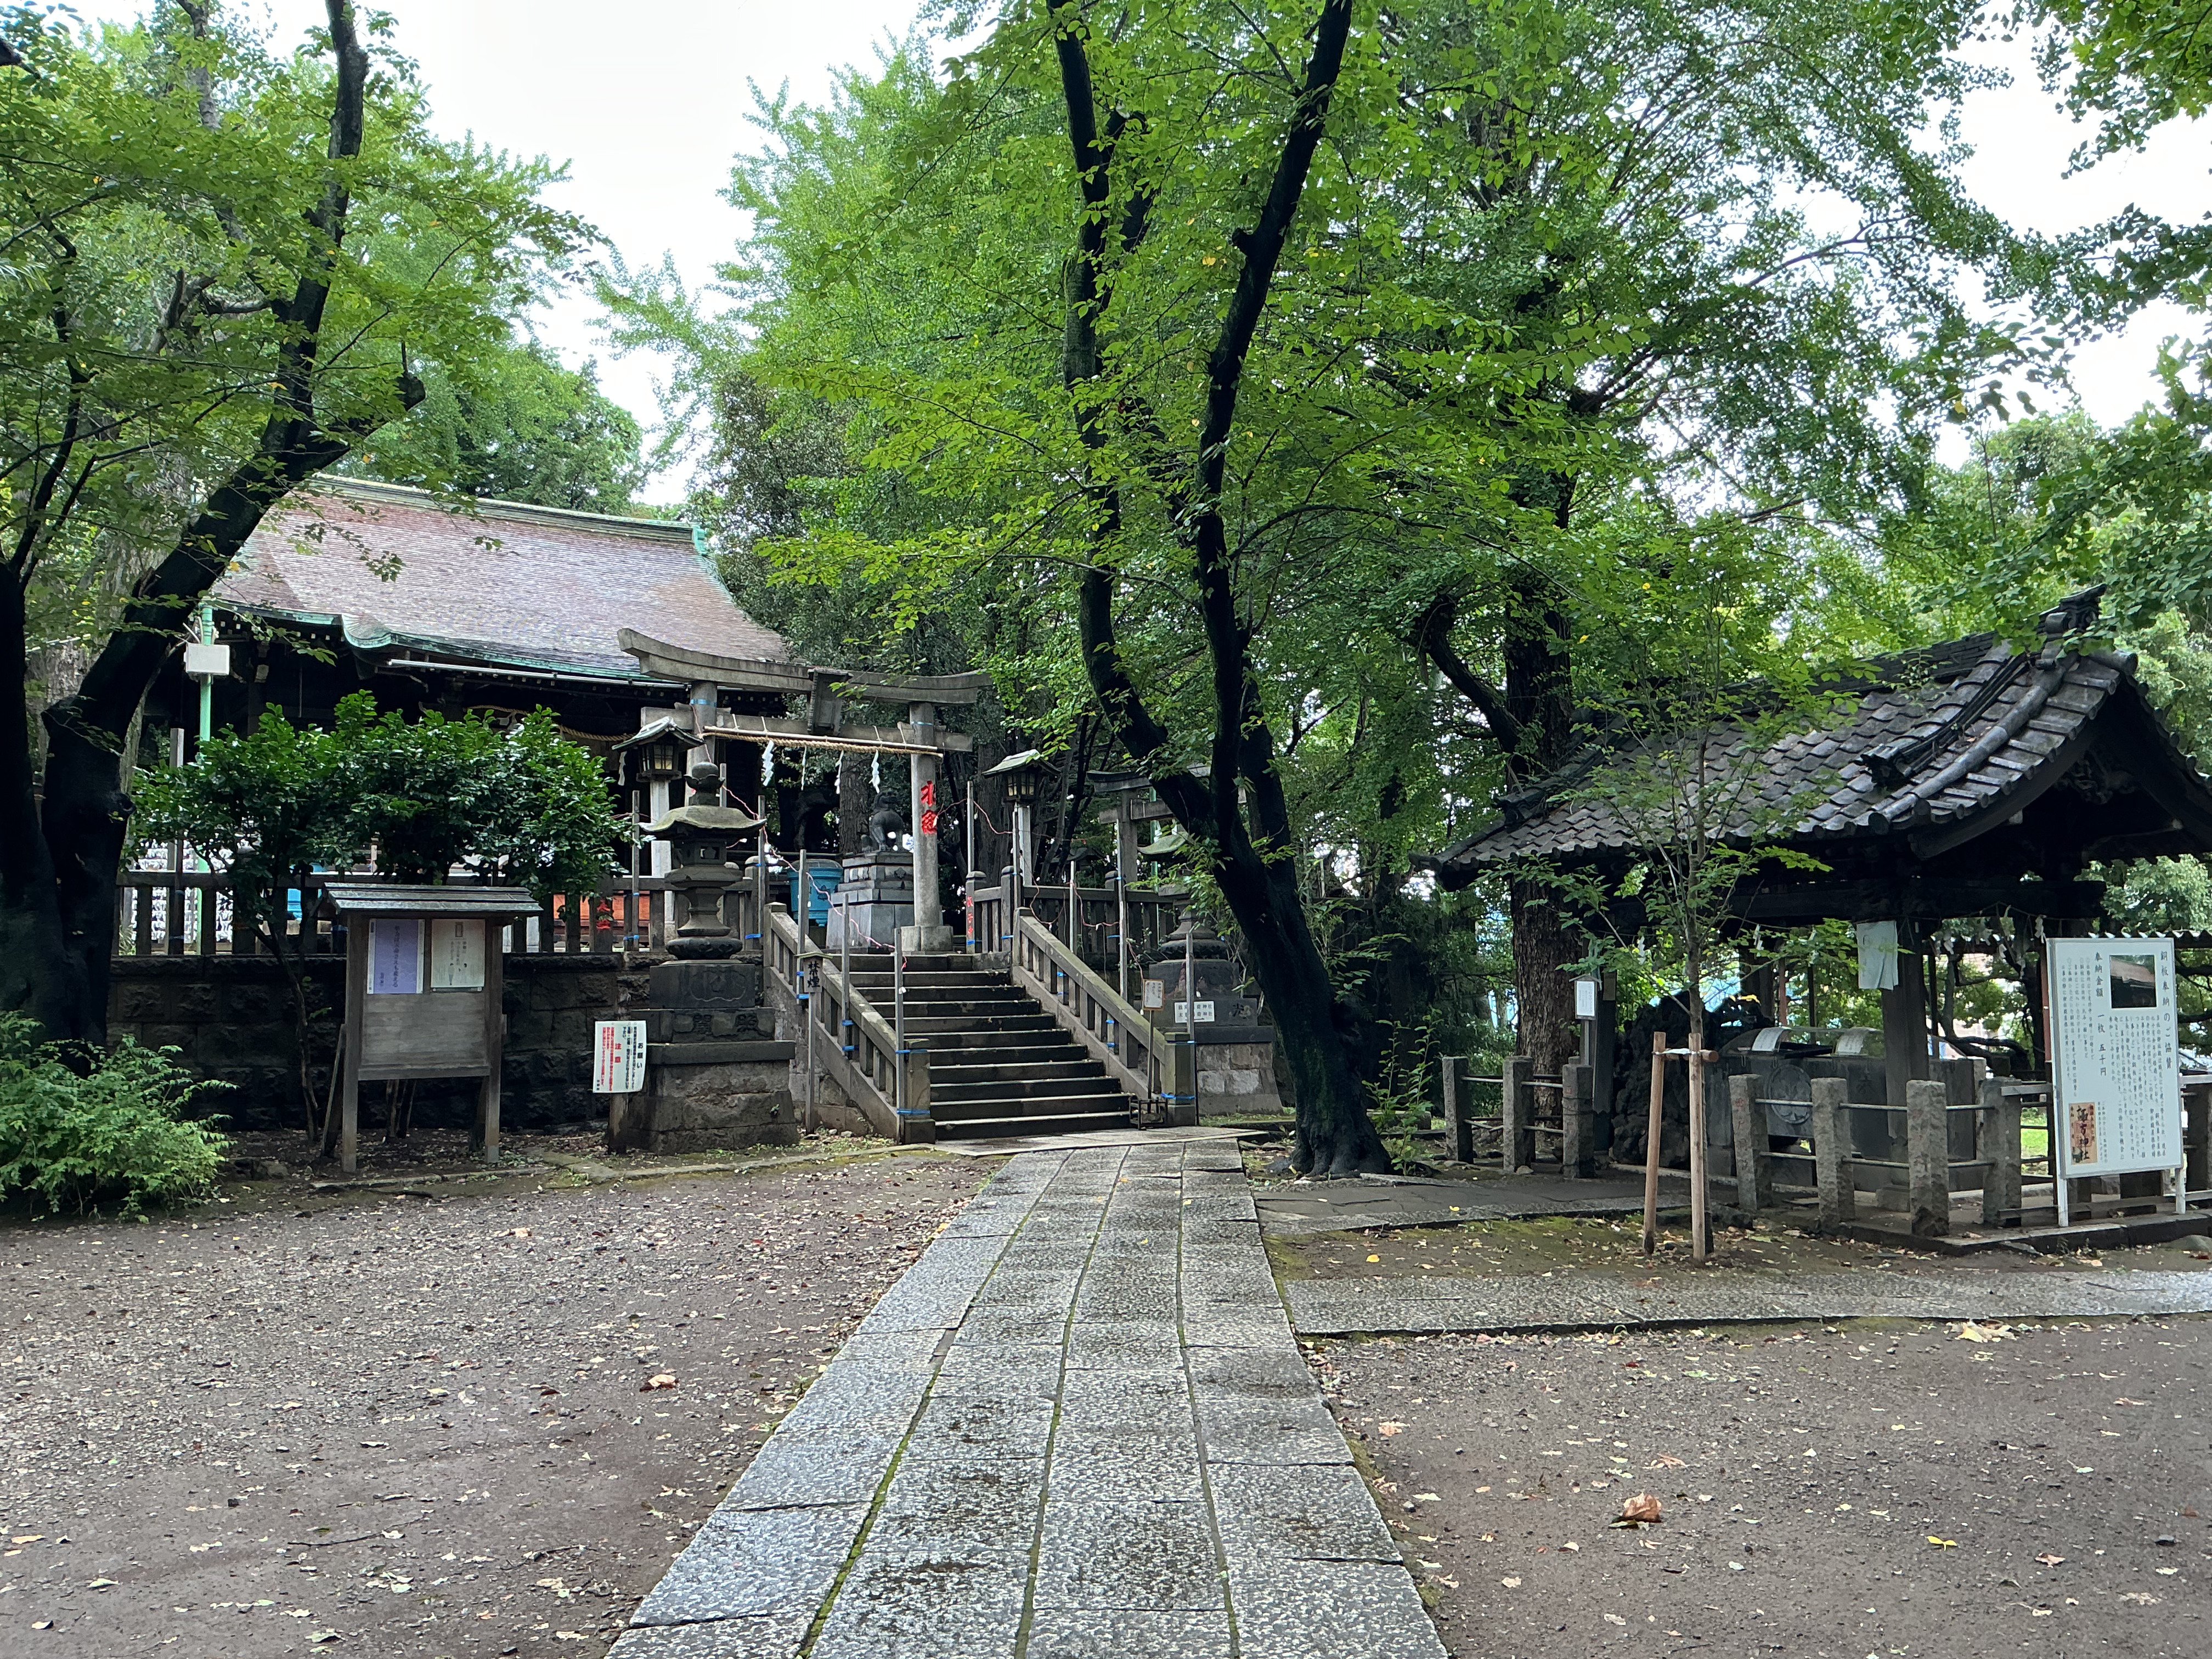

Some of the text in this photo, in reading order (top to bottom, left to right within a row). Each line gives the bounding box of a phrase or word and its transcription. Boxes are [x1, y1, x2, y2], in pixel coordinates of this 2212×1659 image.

[808, 961, 820, 988] 禁煙
[2094, 951, 2107, 1077] 奉納金額 一枚 五千円
[2160, 951, 2172, 1069] 銅板奉納のご協賛
